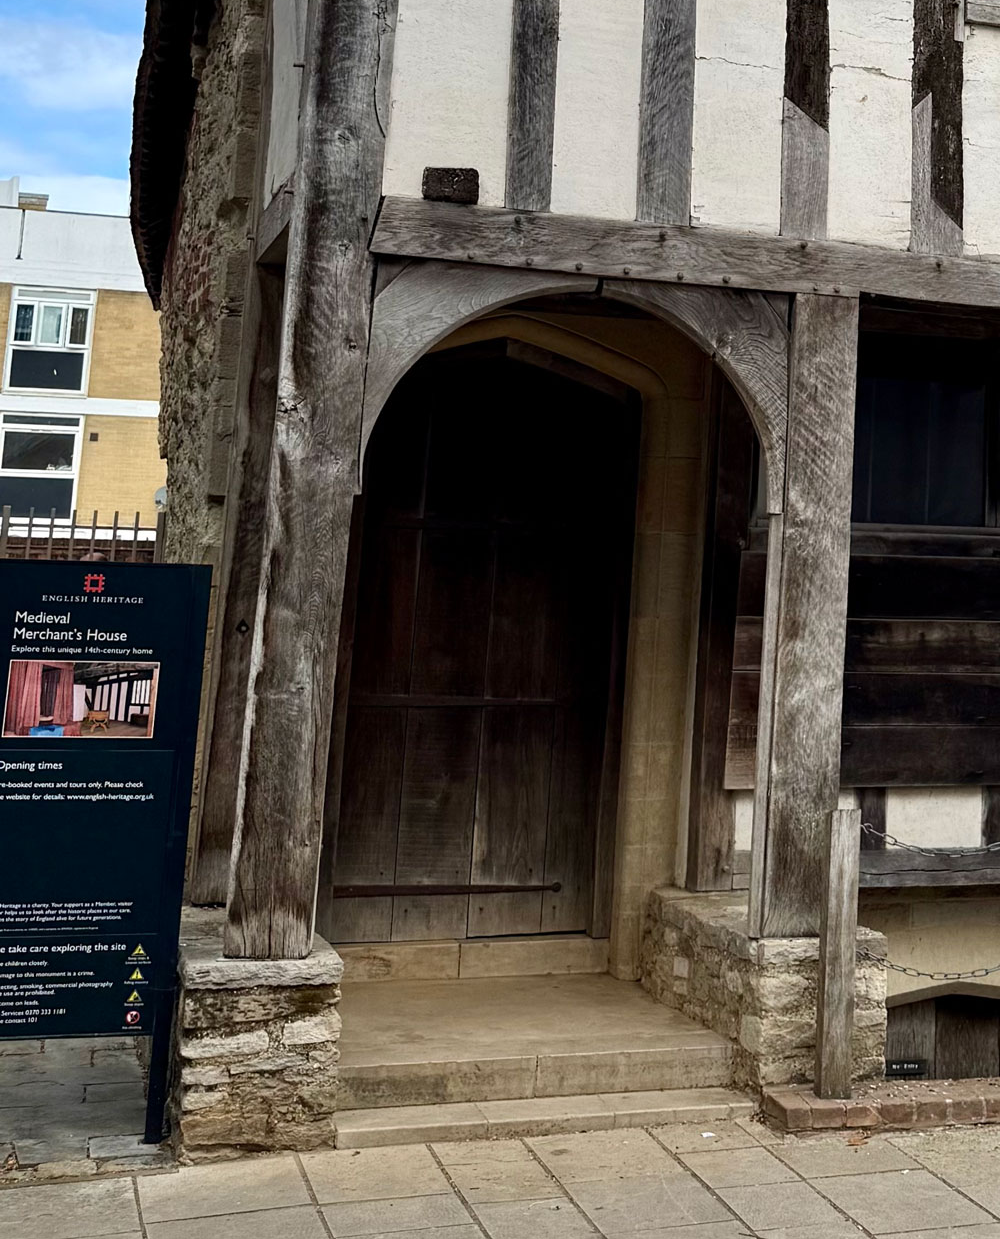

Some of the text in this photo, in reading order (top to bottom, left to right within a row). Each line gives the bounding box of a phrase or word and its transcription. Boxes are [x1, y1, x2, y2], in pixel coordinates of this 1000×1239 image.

[42, 595, 144, 604] ENGLISH HERITAGE
[15, 611, 71, 624] Medieval
[13, 627, 128, 642] Merchant's House
[11, 645, 154, 656] Explore this unique 14th-century home
[38, 760, 63, 770] times
[88, 781, 103, 790] only.
[36, 915, 55, 923] England
[8, 945, 27, 953] take
[29, 945, 49, 953] care
[51, 943, 92, 954] exploring
[94, 942, 109, 951] the
[110, 942, 127, 951] site
[78, 981, 114, 989] photography
